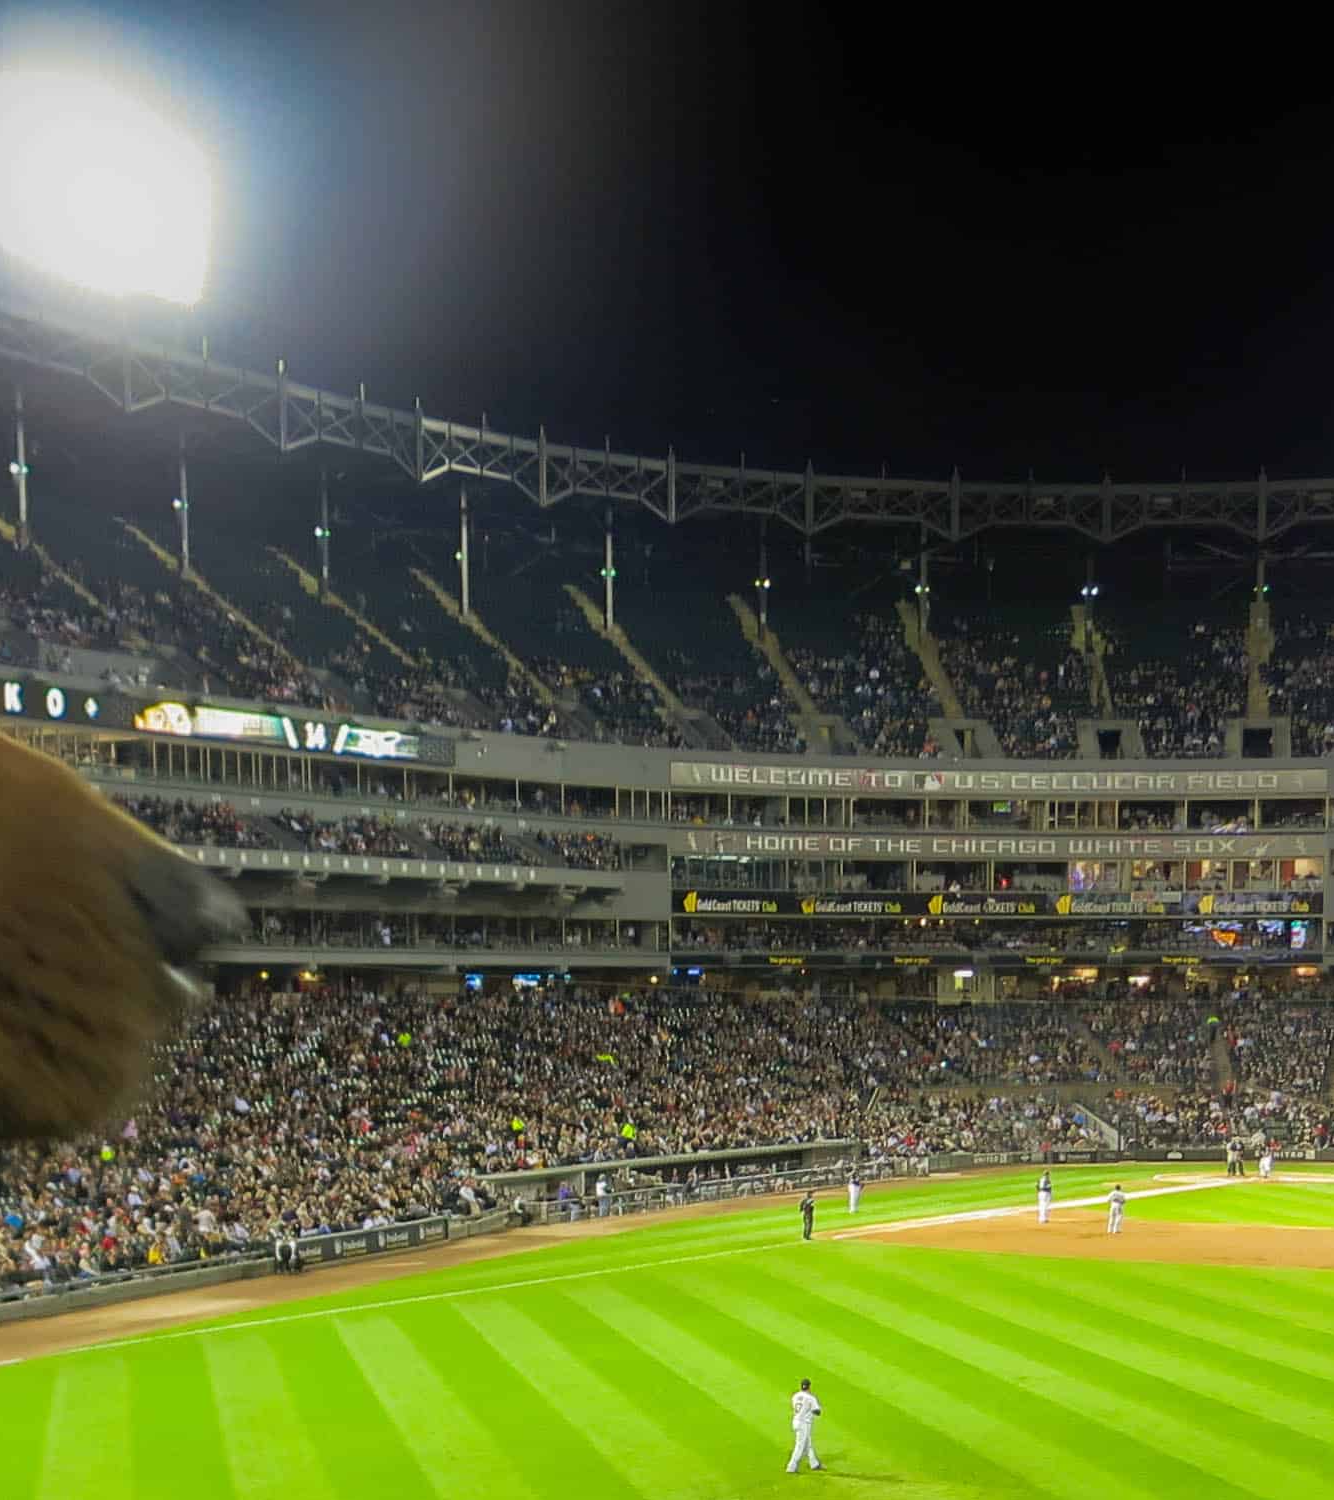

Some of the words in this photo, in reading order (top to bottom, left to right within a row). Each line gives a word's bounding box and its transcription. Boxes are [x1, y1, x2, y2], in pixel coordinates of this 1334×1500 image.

[710, 766, 851, 787] WELCOME
[865, 770, 902, 787] TO
[1010, 774, 1176, 791] CELLULAR
[1188, 774, 1279, 790] FIELD
[745, 834, 820, 852] HOME
[828, 835, 863, 852] OF
[874, 837, 921, 853] THE
[932, 838, 1056, 854] CHICAGO
[1068, 838, 1162, 854] WHITE
[1173, 838, 1236, 854] SOX
